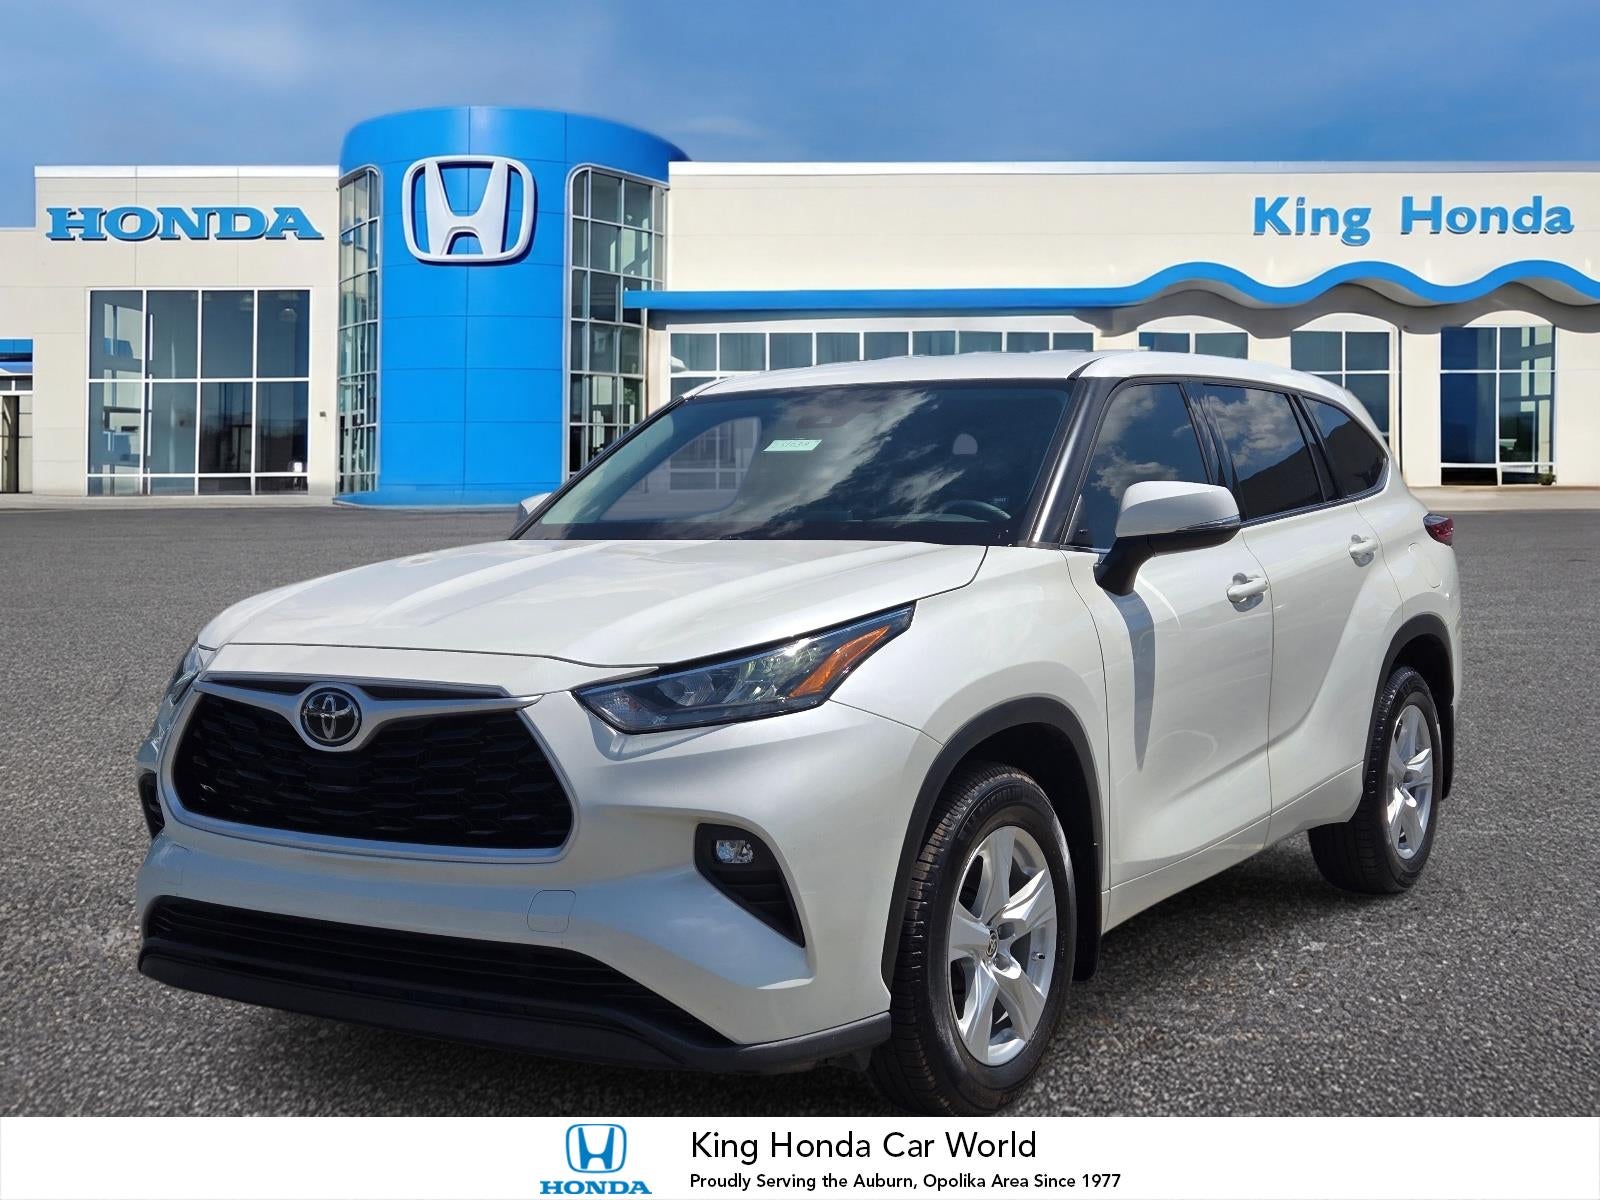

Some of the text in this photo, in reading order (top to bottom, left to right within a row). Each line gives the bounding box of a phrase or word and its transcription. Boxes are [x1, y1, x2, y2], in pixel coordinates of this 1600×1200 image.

[45, 205, 325, 242] HONDA
[1252, 194, 1575, 246] King Honda
